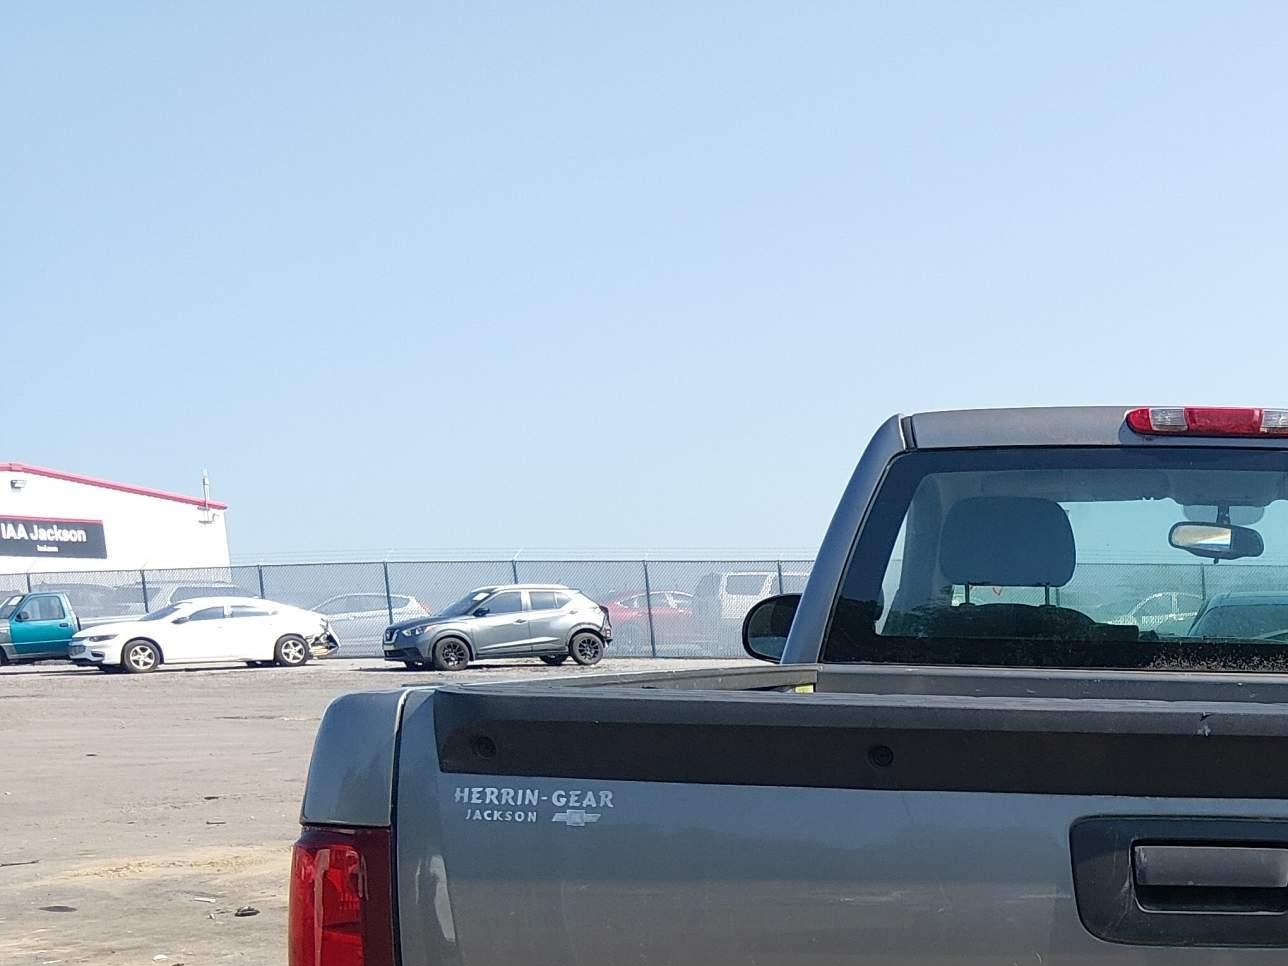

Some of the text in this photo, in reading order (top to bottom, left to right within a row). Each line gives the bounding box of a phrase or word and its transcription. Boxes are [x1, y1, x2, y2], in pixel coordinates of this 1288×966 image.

[1, 523, 87, 542] IAA Jackson
[454, 787, 615, 808] HERRIN-GEAR
[465, 809, 538, 823] JACKSON
